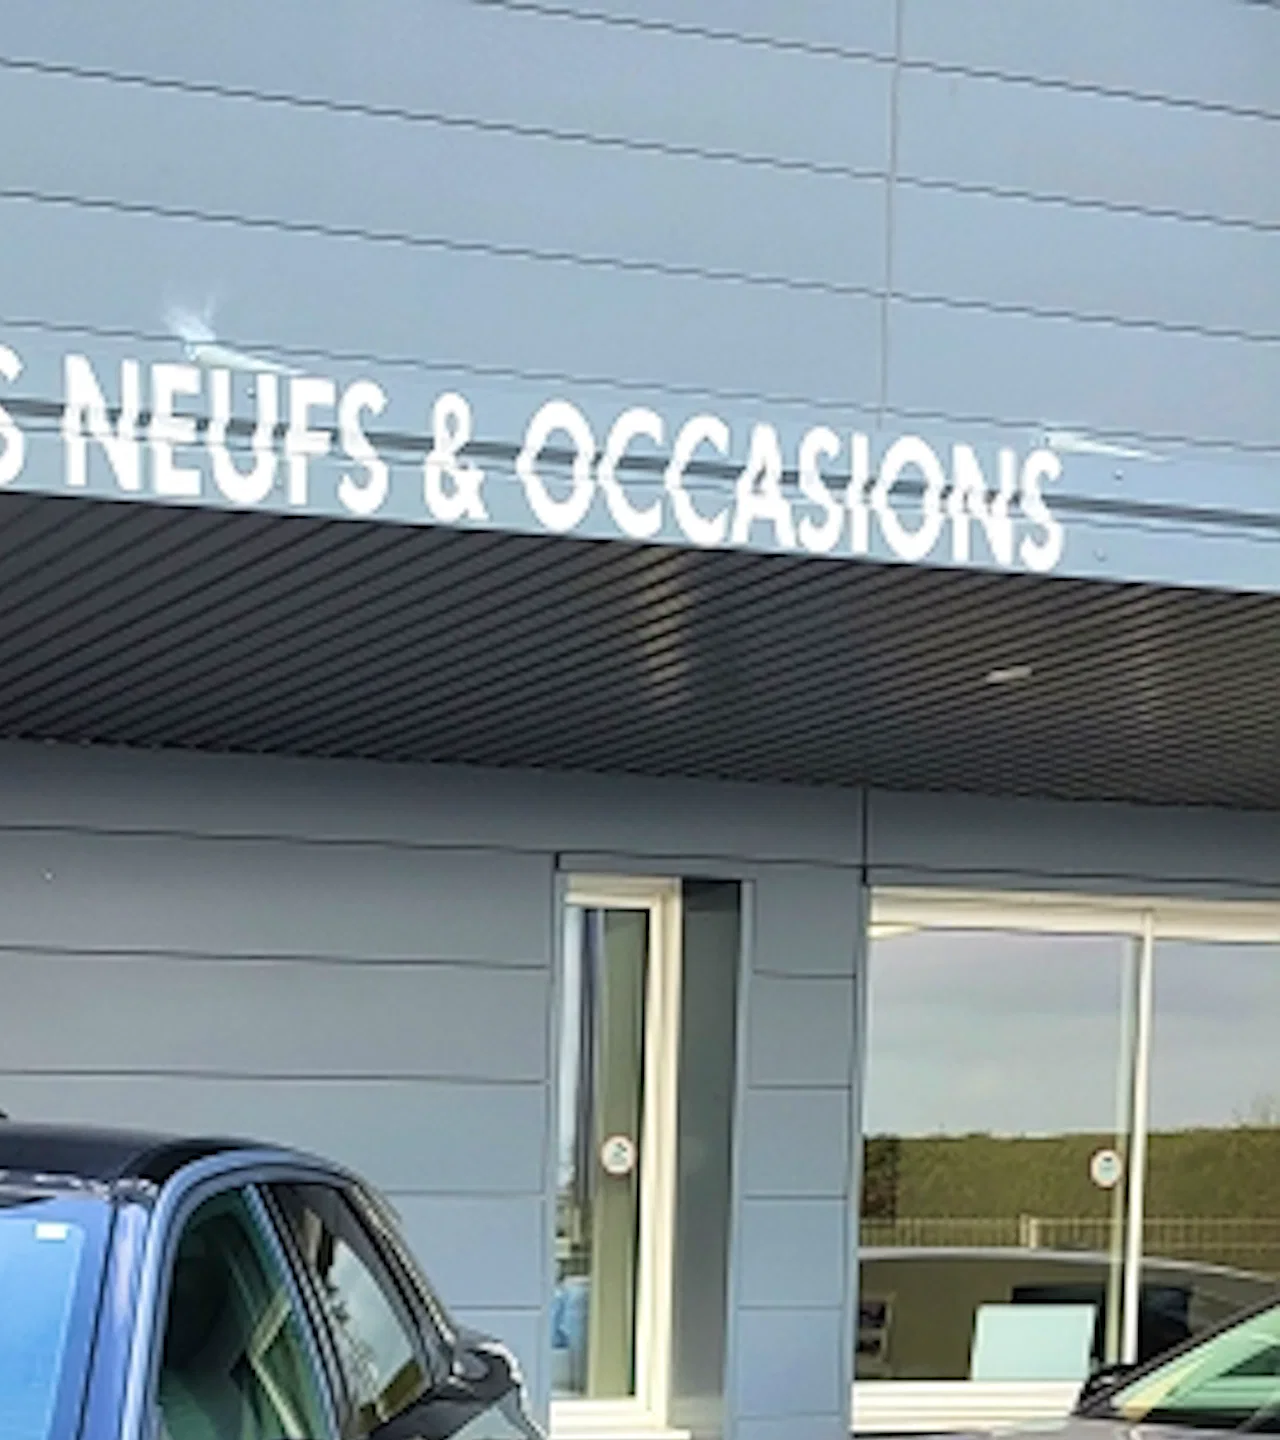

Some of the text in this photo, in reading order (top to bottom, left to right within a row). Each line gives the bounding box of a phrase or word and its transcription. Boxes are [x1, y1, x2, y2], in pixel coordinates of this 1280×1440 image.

[62, 355, 390, 515] NEUFS
[423, 391, 489, 523] &
[516, 400, 1065, 572] OCCASIONS
